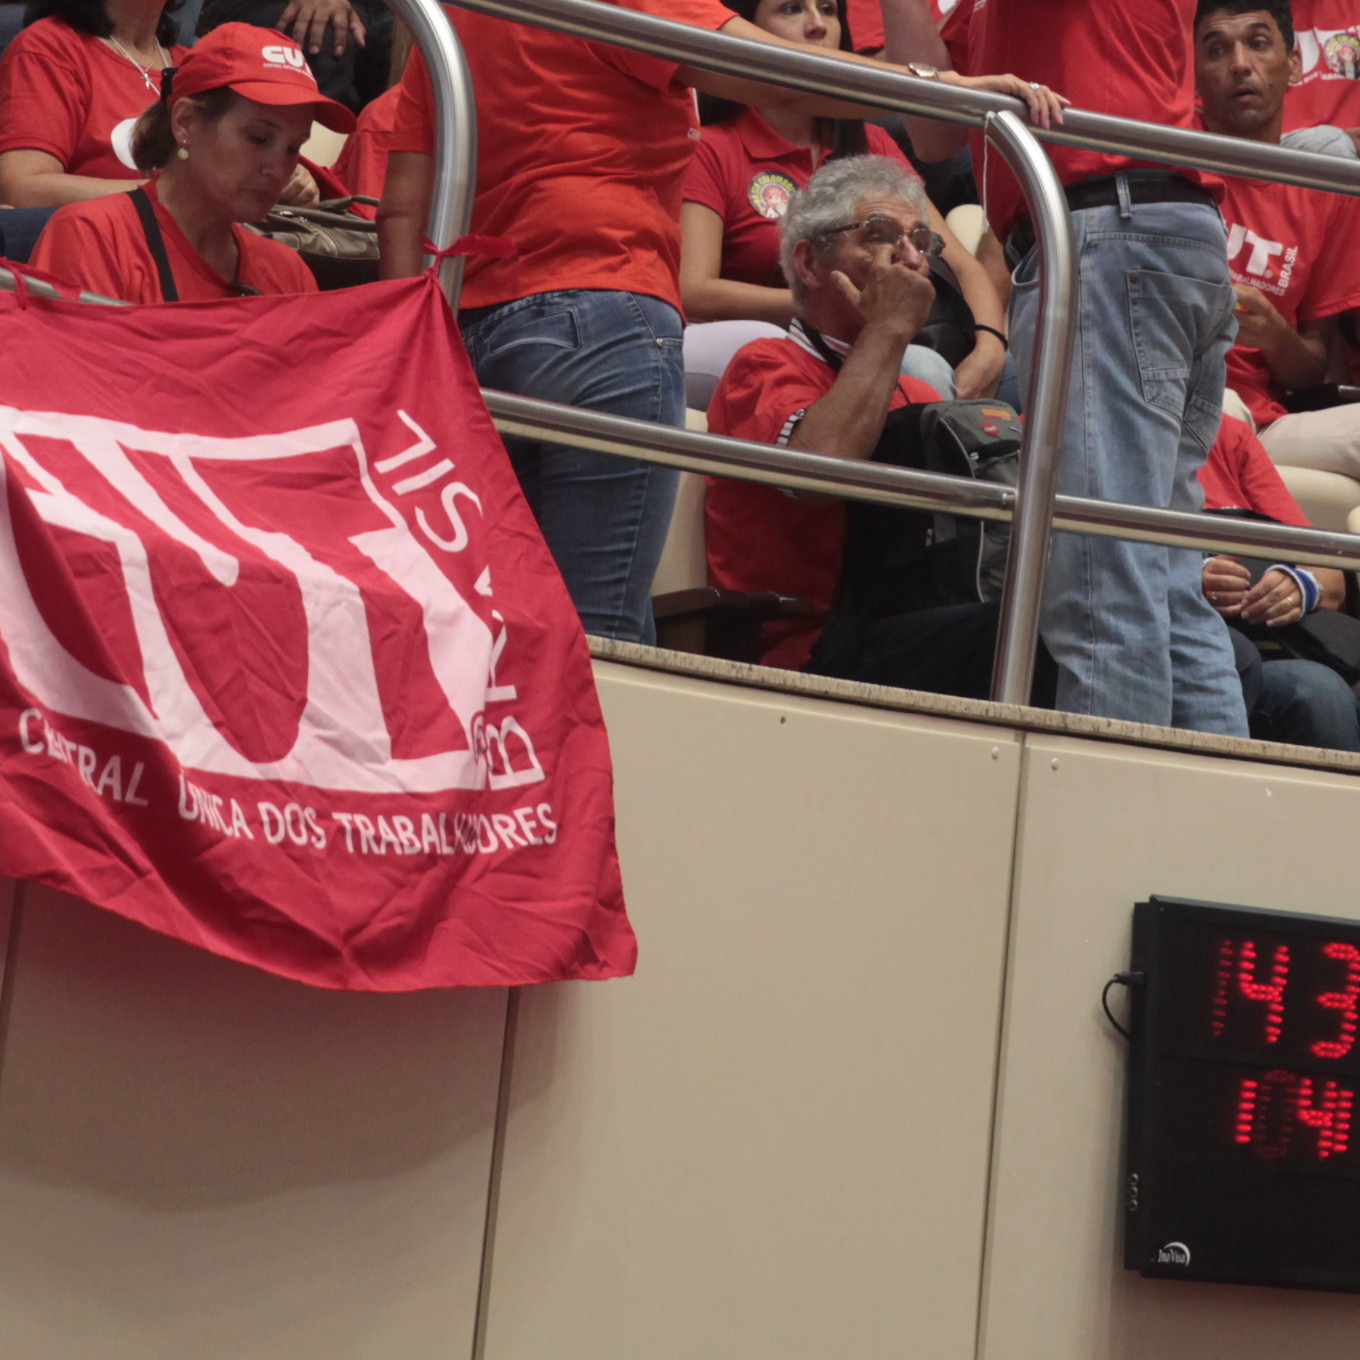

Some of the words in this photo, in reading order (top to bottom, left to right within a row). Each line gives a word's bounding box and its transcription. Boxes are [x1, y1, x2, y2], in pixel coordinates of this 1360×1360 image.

[262, 45, 306, 68] CU
[1278, 245, 1299, 289] BRASIL
[257, 801, 327, 849] DOS
